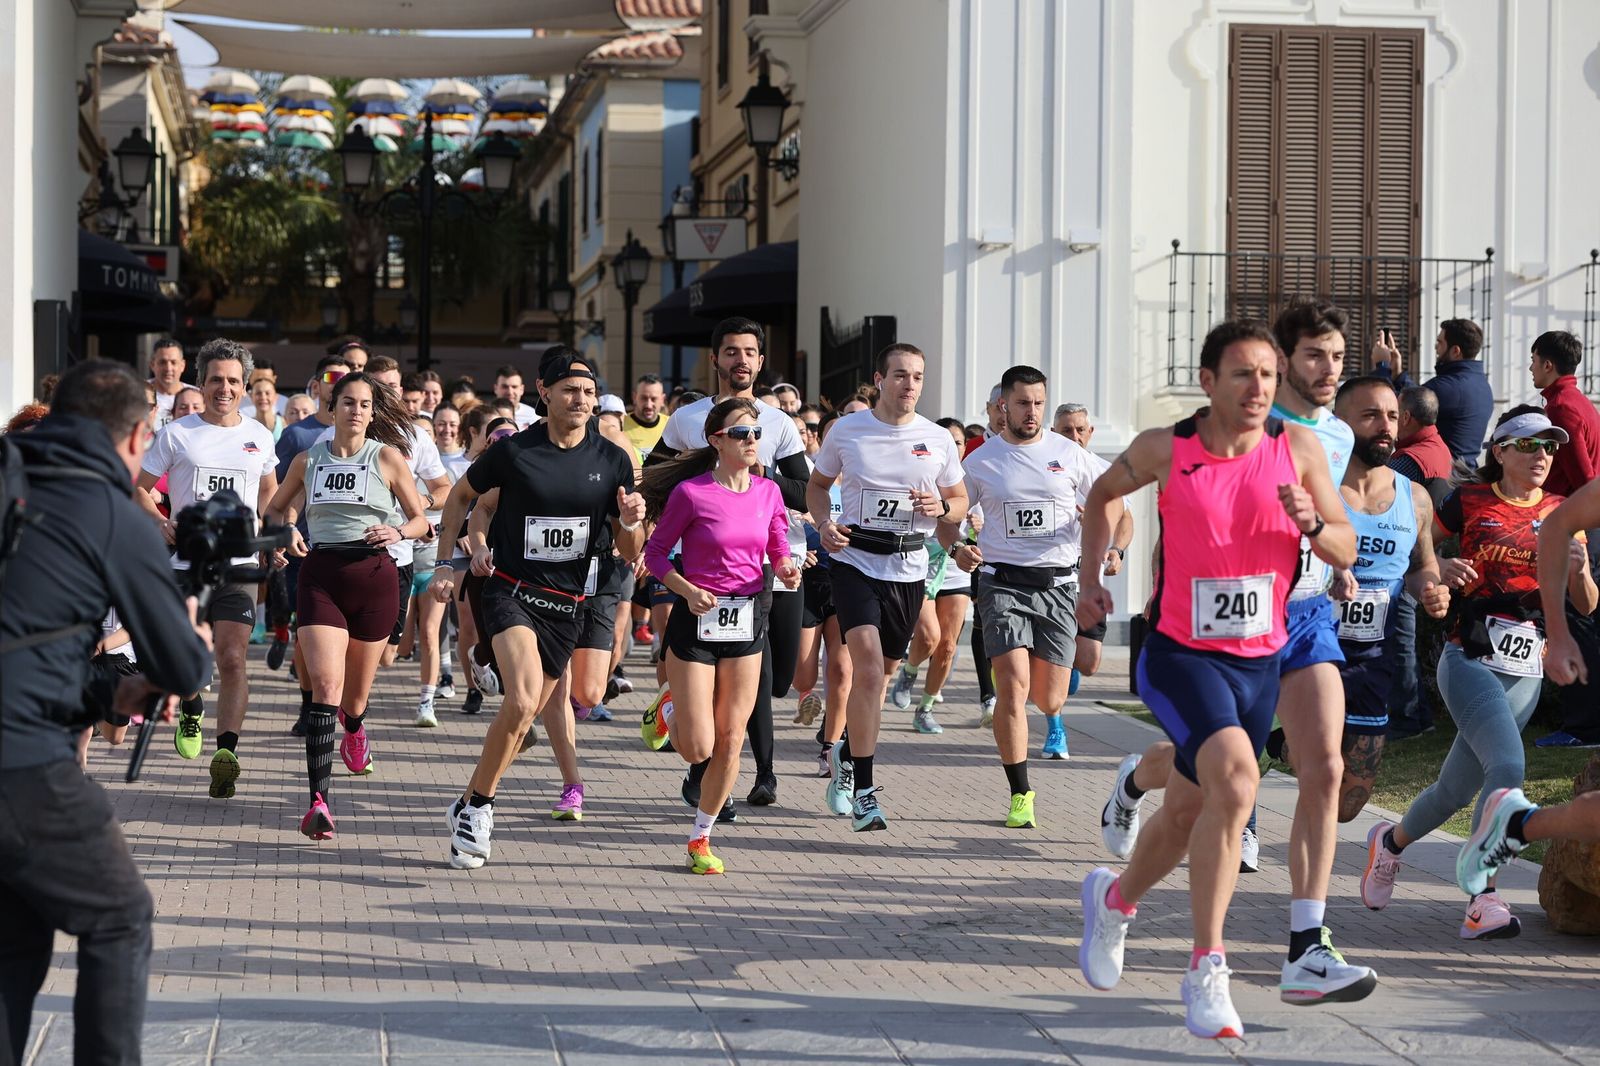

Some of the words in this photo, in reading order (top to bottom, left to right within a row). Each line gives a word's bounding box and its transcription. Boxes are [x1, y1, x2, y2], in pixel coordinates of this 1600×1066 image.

[208, 475, 235, 492] 501
[324, 472, 356, 491] 408
[877, 499, 899, 518] 27
[1016, 509, 1043, 527] 123
[542, 528, 574, 548] 108
[1356, 535, 1396, 556] ESO
[1475, 543, 1508, 562] XII
[518, 591, 574, 613] WONG
[1215, 590, 1258, 620] 240
[718, 607, 739, 627] 84
[1340, 601, 1375, 624] 169
[1497, 633, 1534, 660] 425
